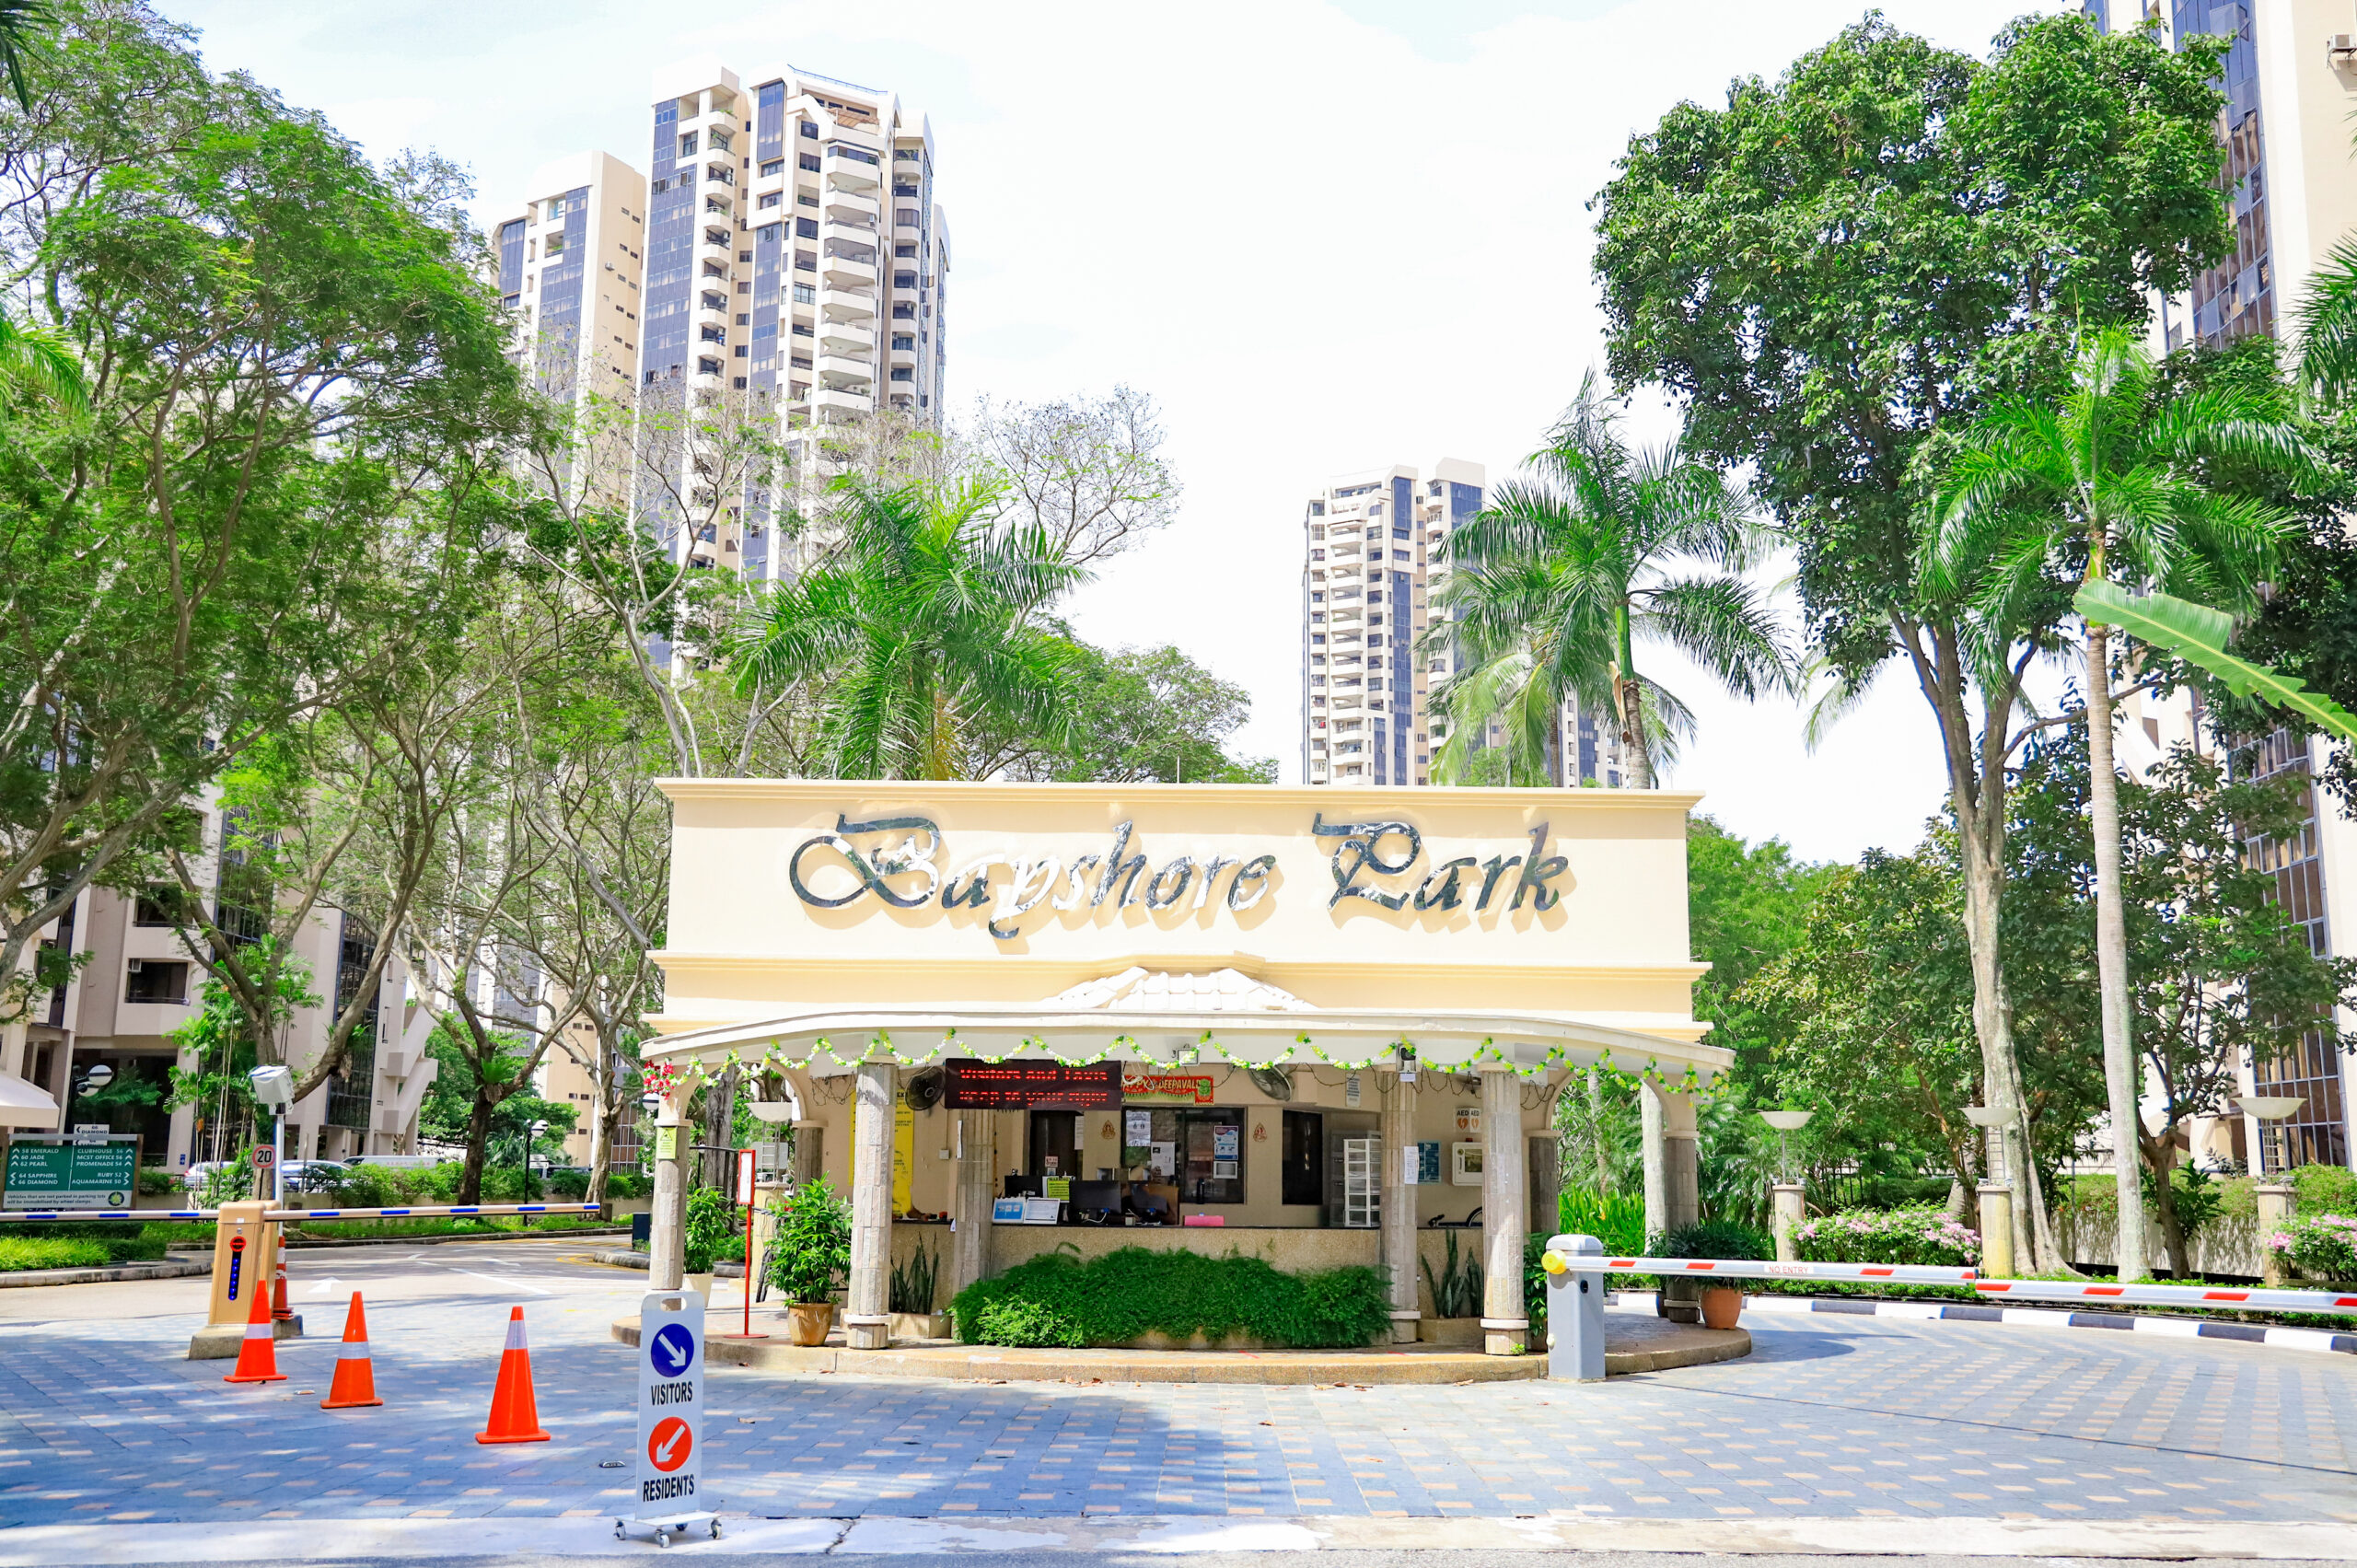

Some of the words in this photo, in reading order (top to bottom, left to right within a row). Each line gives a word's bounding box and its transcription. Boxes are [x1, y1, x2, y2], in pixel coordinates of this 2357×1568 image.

[789, 812, 1277, 939] Bayshore
[1311, 812, 1569, 912] Park
[1026, 1067, 1057, 1080] and
[257, 1150, 273, 1163] 20
[1783, 1266, 1808, 1274] ENTRY
[650, 1380, 692, 1406] VISITORS
[643, 1473, 695, 1503] RESIDENTS
